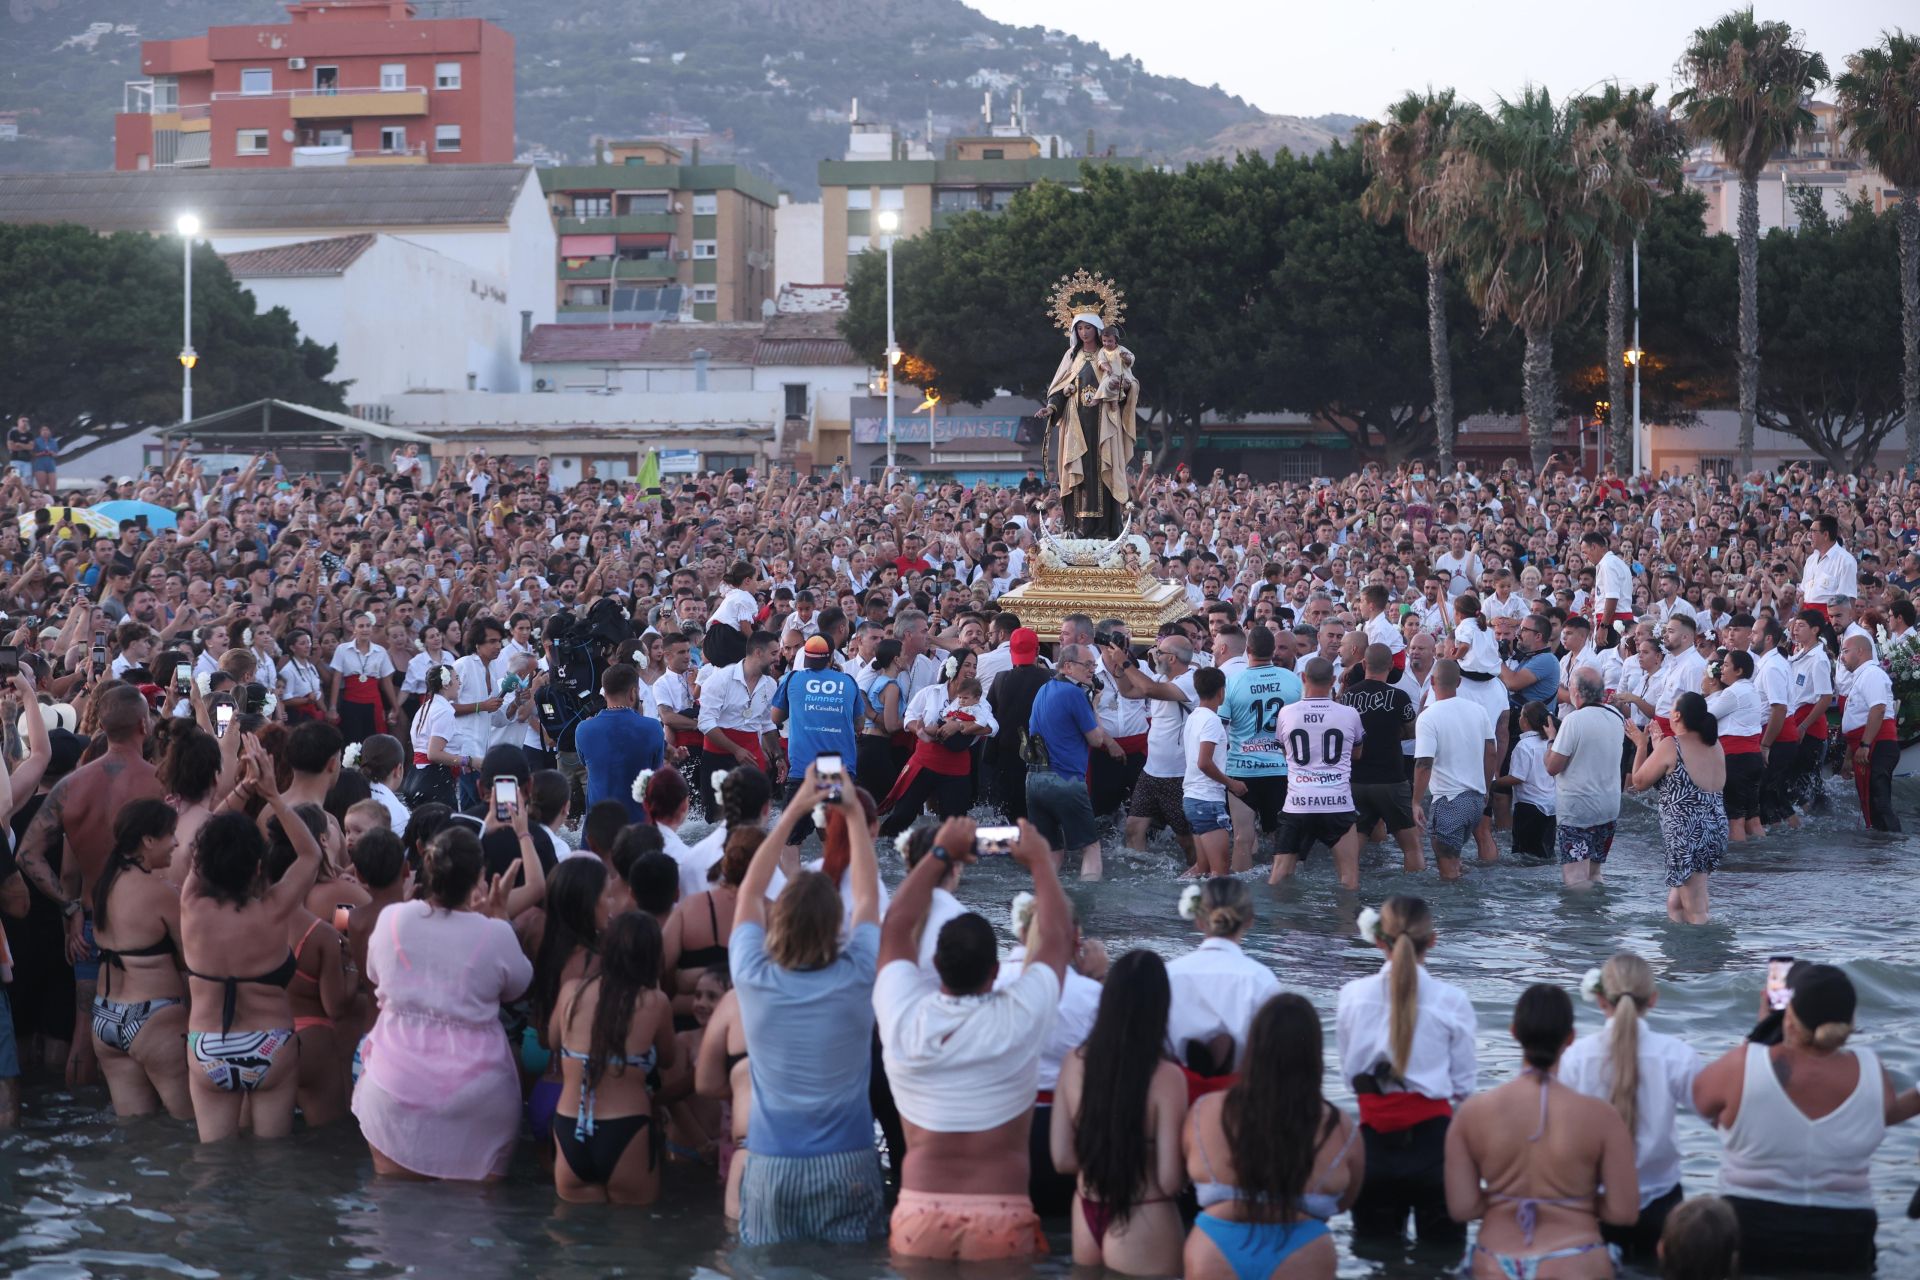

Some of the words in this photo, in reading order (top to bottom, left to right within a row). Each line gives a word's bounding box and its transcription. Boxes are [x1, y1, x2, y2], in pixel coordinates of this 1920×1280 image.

[935, 420, 1018, 438] SUNSET
[806, 679, 844, 695] GO!
[1250, 682, 1281, 695] GOMEZ
[805, 695, 844, 703] Runners
[1303, 713, 1325, 723] ROY
[1236, 759, 1253, 769] LAS
[1292, 796, 1306, 806] LAS
[1308, 795, 1347, 806] FAVELAS
